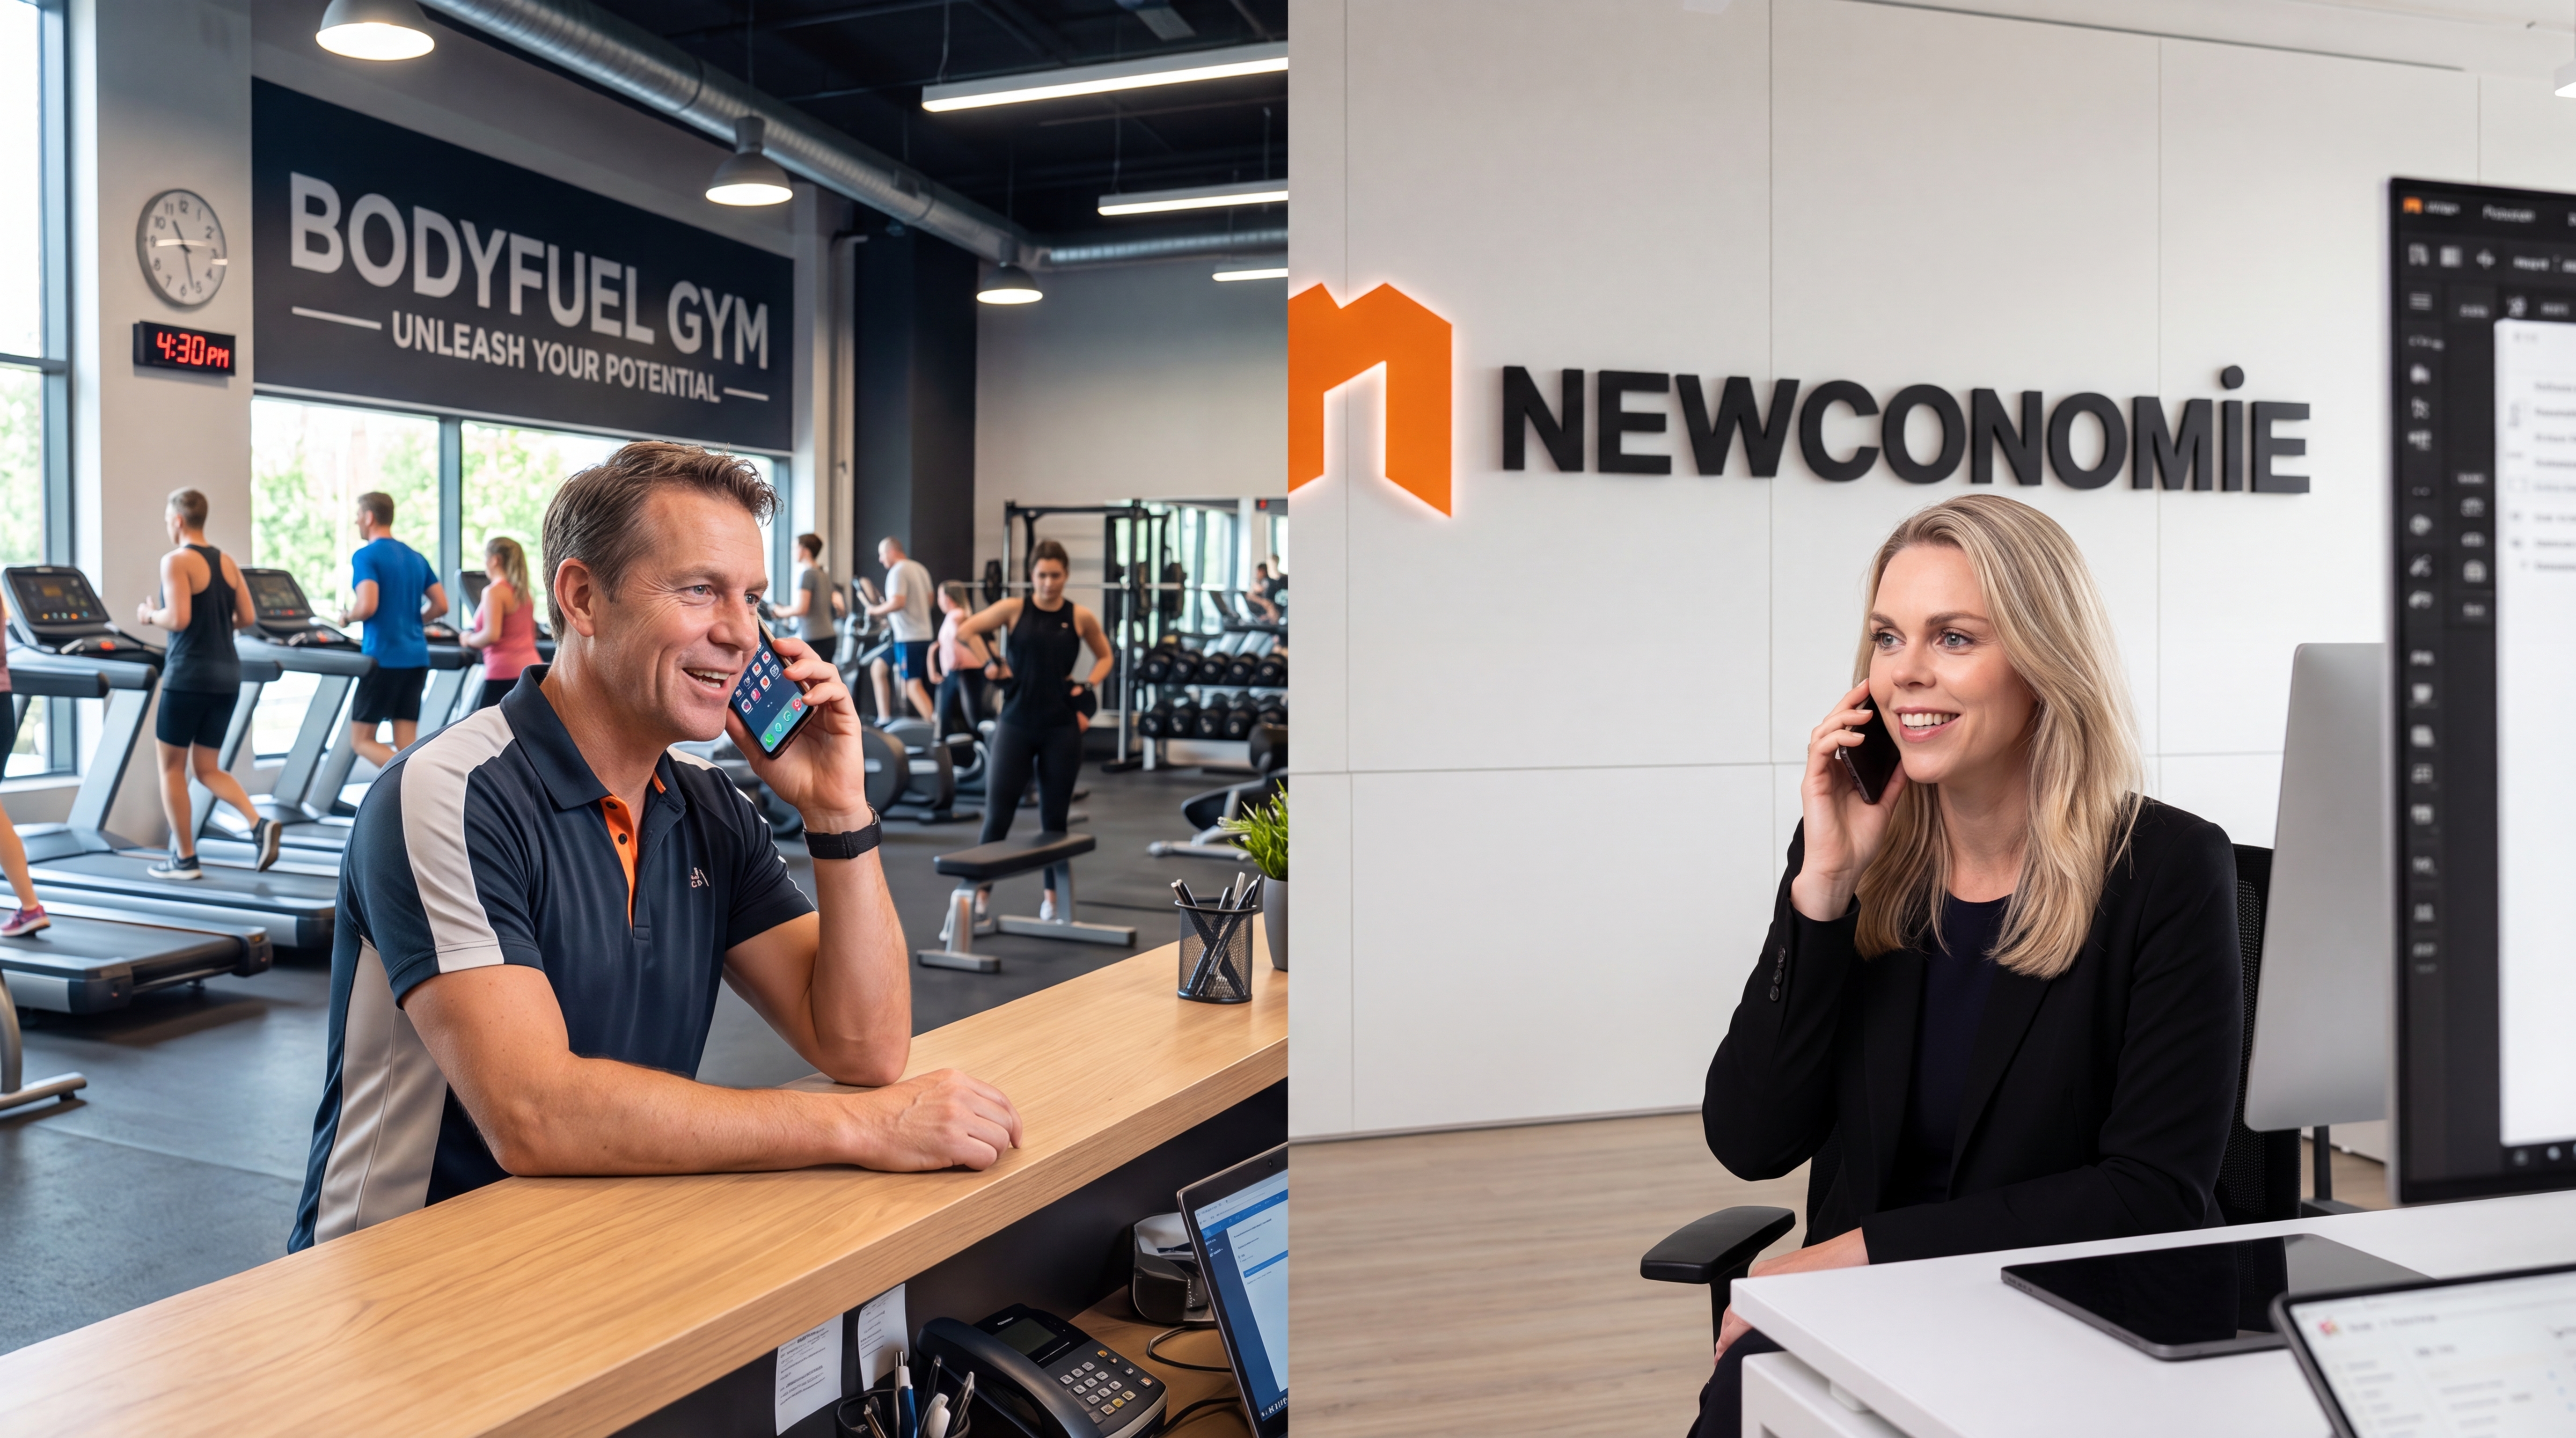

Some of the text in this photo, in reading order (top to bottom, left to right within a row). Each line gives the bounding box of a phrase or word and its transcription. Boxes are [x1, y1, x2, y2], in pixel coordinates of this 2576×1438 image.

[290, 171, 768, 369] BODYFUEL GYM
[392, 310, 721, 403] UNLEASH YOUR POTENTIAL
